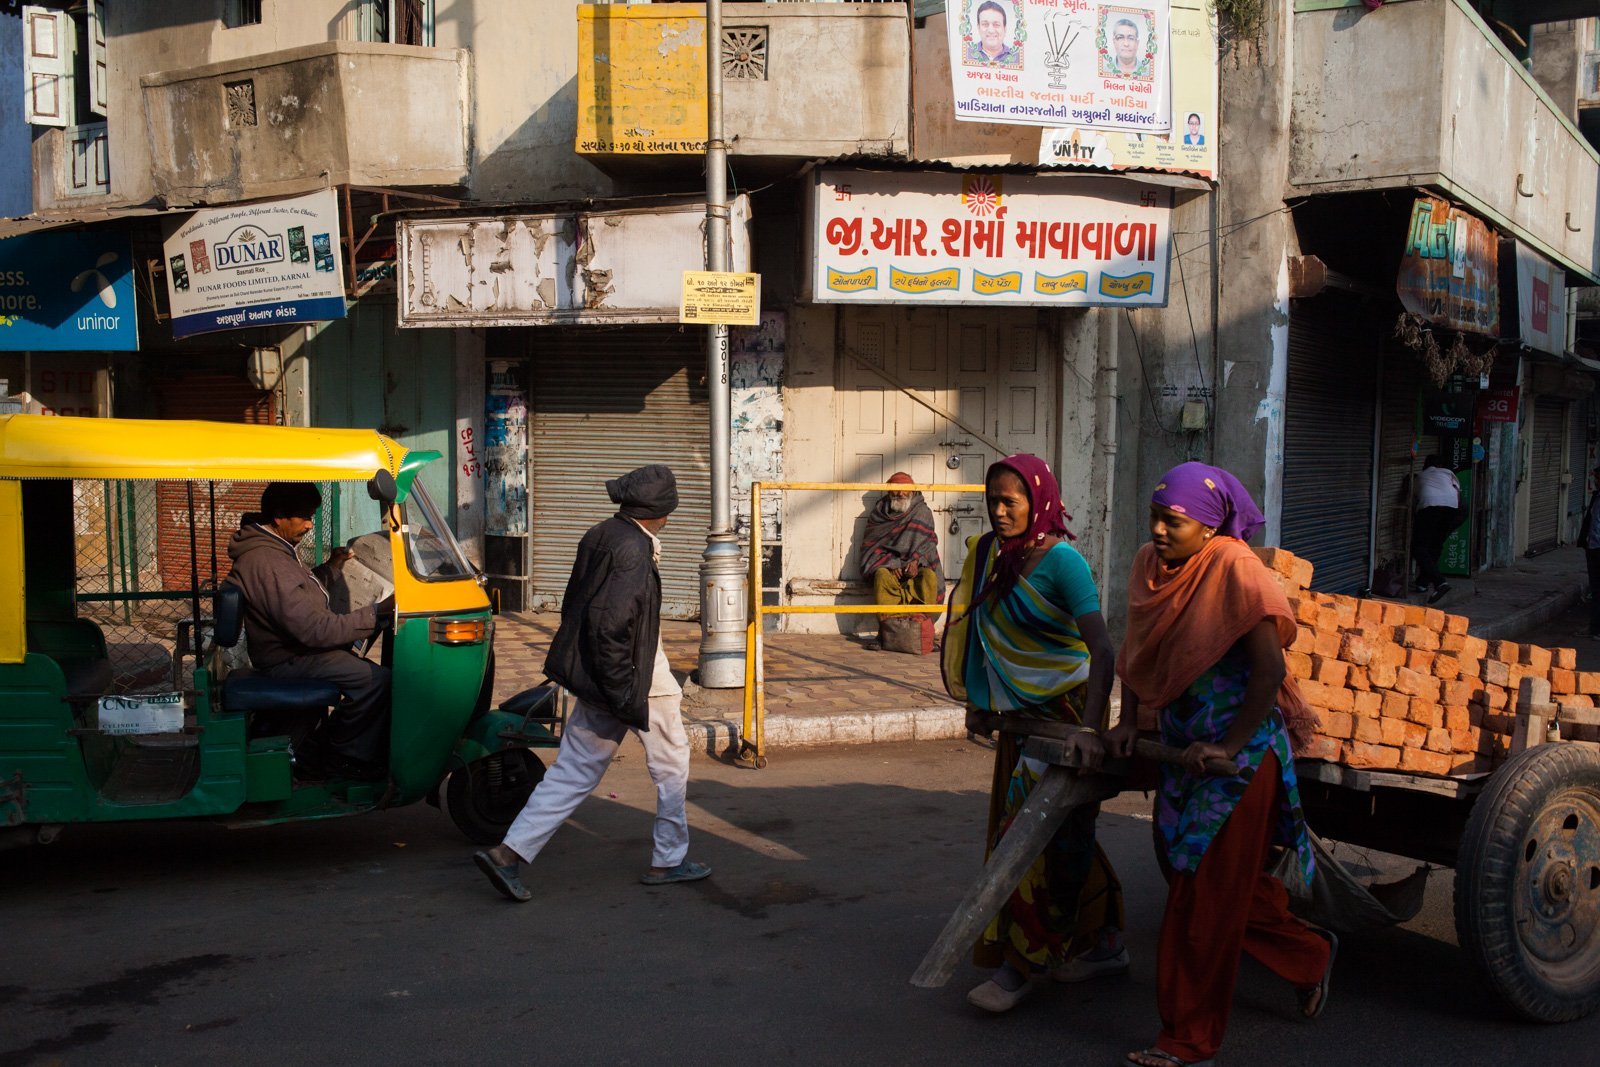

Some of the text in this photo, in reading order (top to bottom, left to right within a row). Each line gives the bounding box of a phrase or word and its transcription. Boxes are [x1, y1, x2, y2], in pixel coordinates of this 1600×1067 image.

[1103, 79, 1126, 91] મિલન
[977, 86, 1024, 99] ભારતીય
[1030, 91, 1064, 104] જનતા
[1070, 91, 1095, 105] પાર્ટી
[1110, 95, 1148, 109] ખાડિયા
[957, 98, 1005, 113] ખાડિયાના
[1010, 104, 1067, 118] નગરજનોની
[1072, 108, 1111, 123] અશ્રુભરી
[581, 138, 606, 152] સવારે
[647, 141, 678, 152] રાતના
[208, 214, 230, 228] Different
[248, 207, 272, 218] Different
[1016, 221, 1157, 262] માવાવાળા
[217, 238, 282, 267] DUNAR
[236, 268, 254, 276] Basmati
[197, 272, 311, 293] DUNAR FOODS LIMITED, KARNAL
[77, 312, 121, 330] uninor
[249, 310, 273, 321] અનાજ
[276, 305, 297, 318] ભંડાર
[41, 371, 93, 393] STD
[1487, 399, 1508, 412] 3G
[1429, 415, 1466, 423] VIDEOCON
[102, 696, 140, 711] CNG
